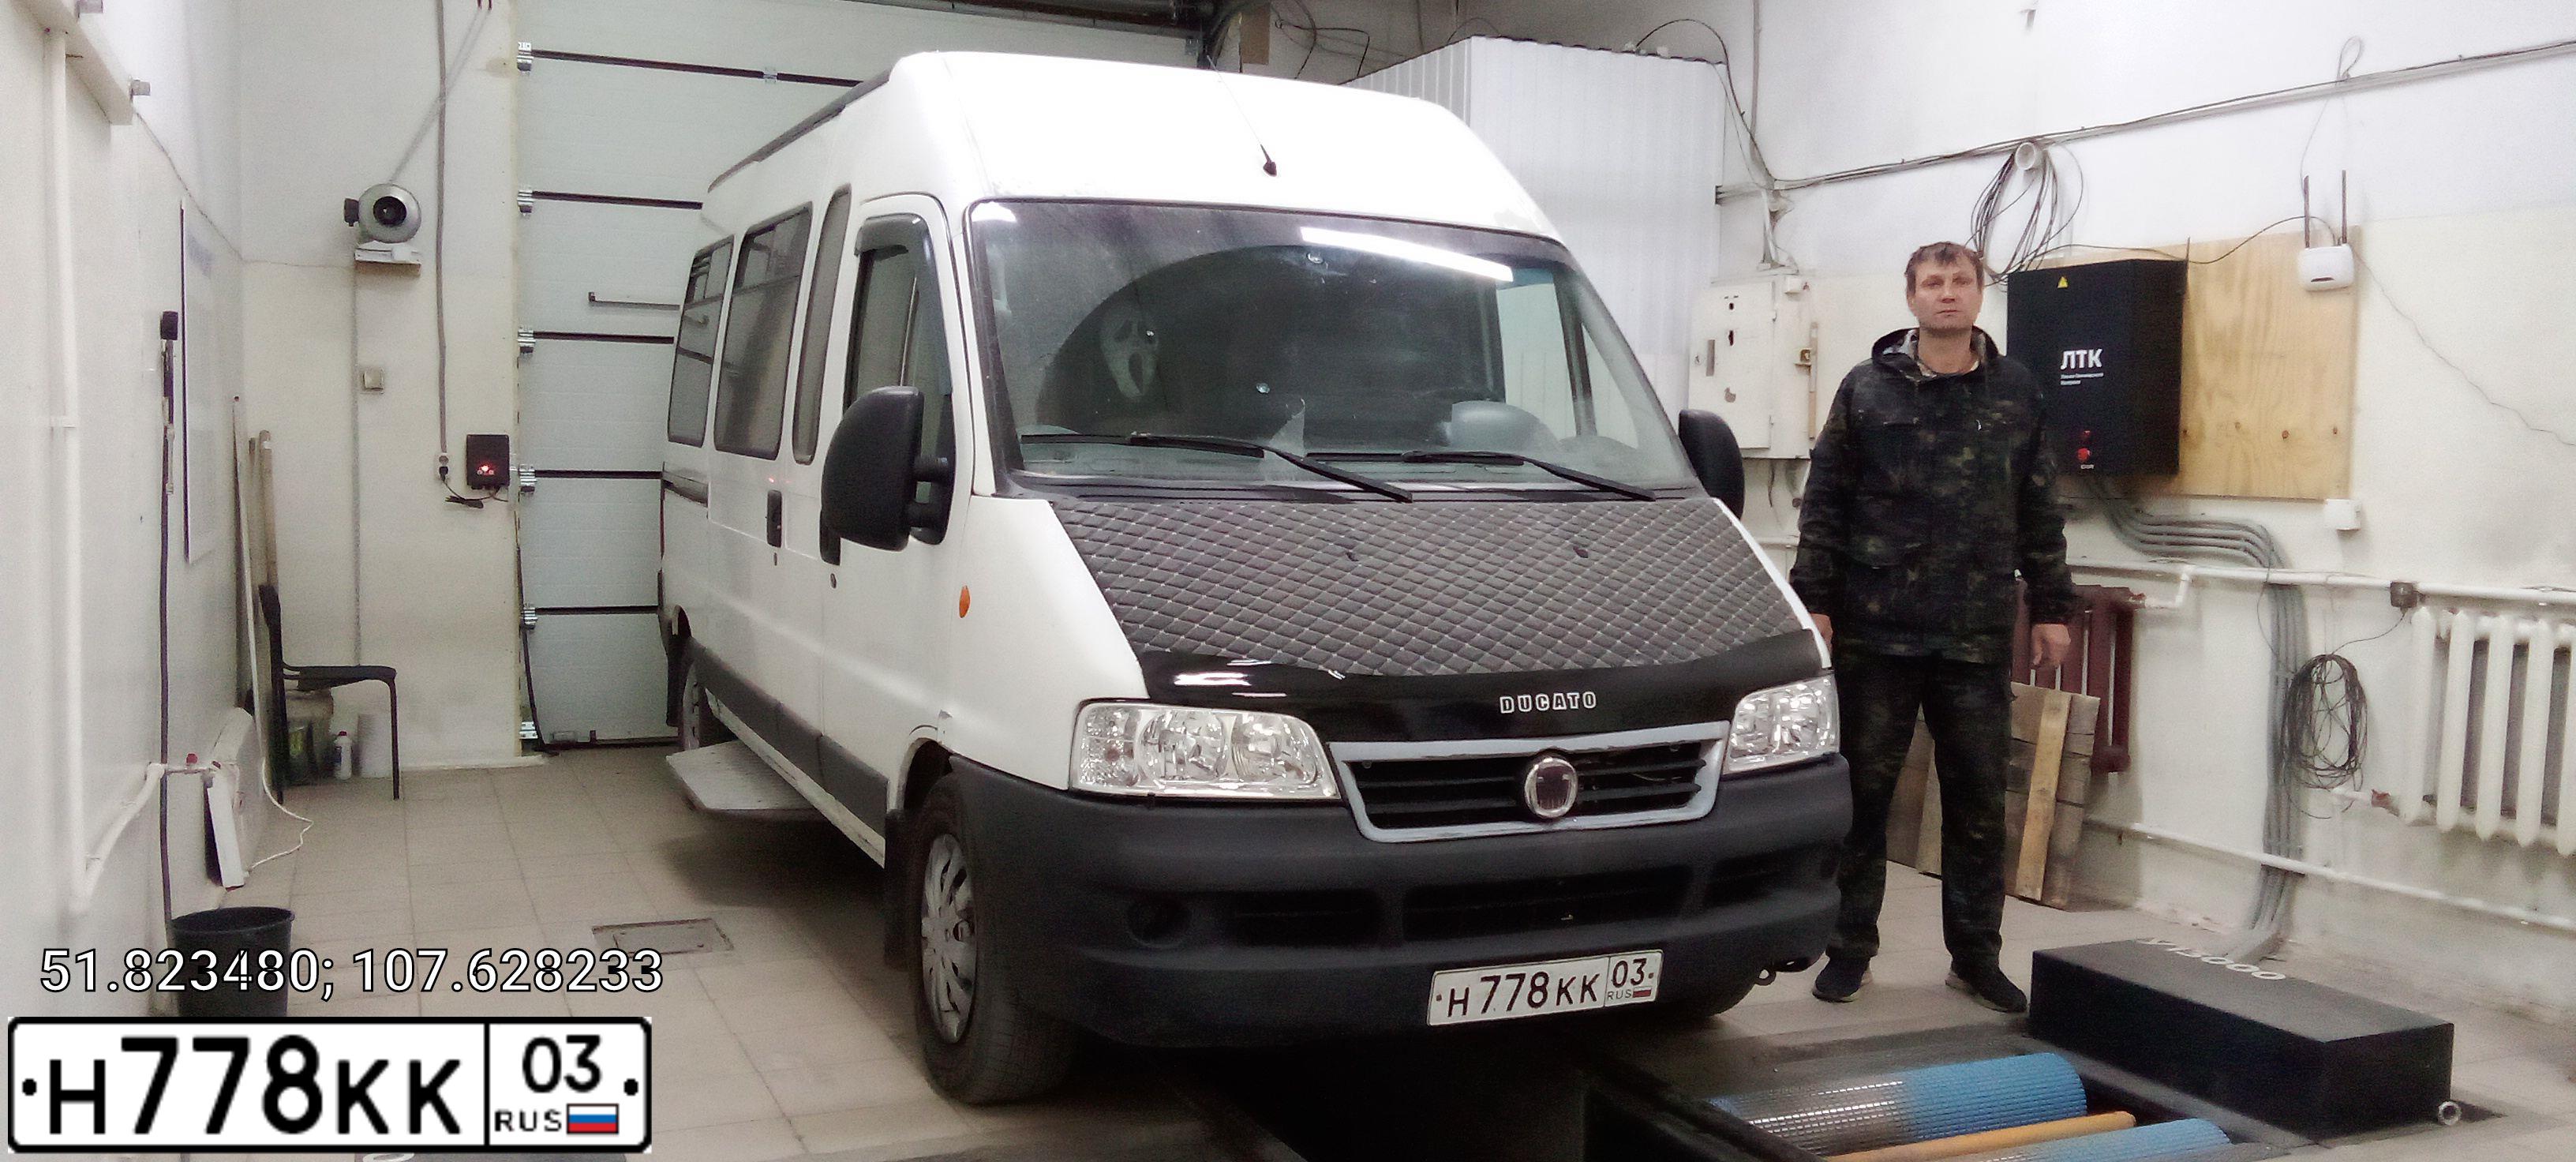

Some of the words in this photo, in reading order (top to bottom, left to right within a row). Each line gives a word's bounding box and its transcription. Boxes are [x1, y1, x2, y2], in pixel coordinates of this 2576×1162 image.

[2061, 348, 2102, 369] ЛТК
[1500, 691, 1597, 714] DUCATO
[1612, 958, 1647, 988] 03
[1607, 988, 1632, 1000] RUS
